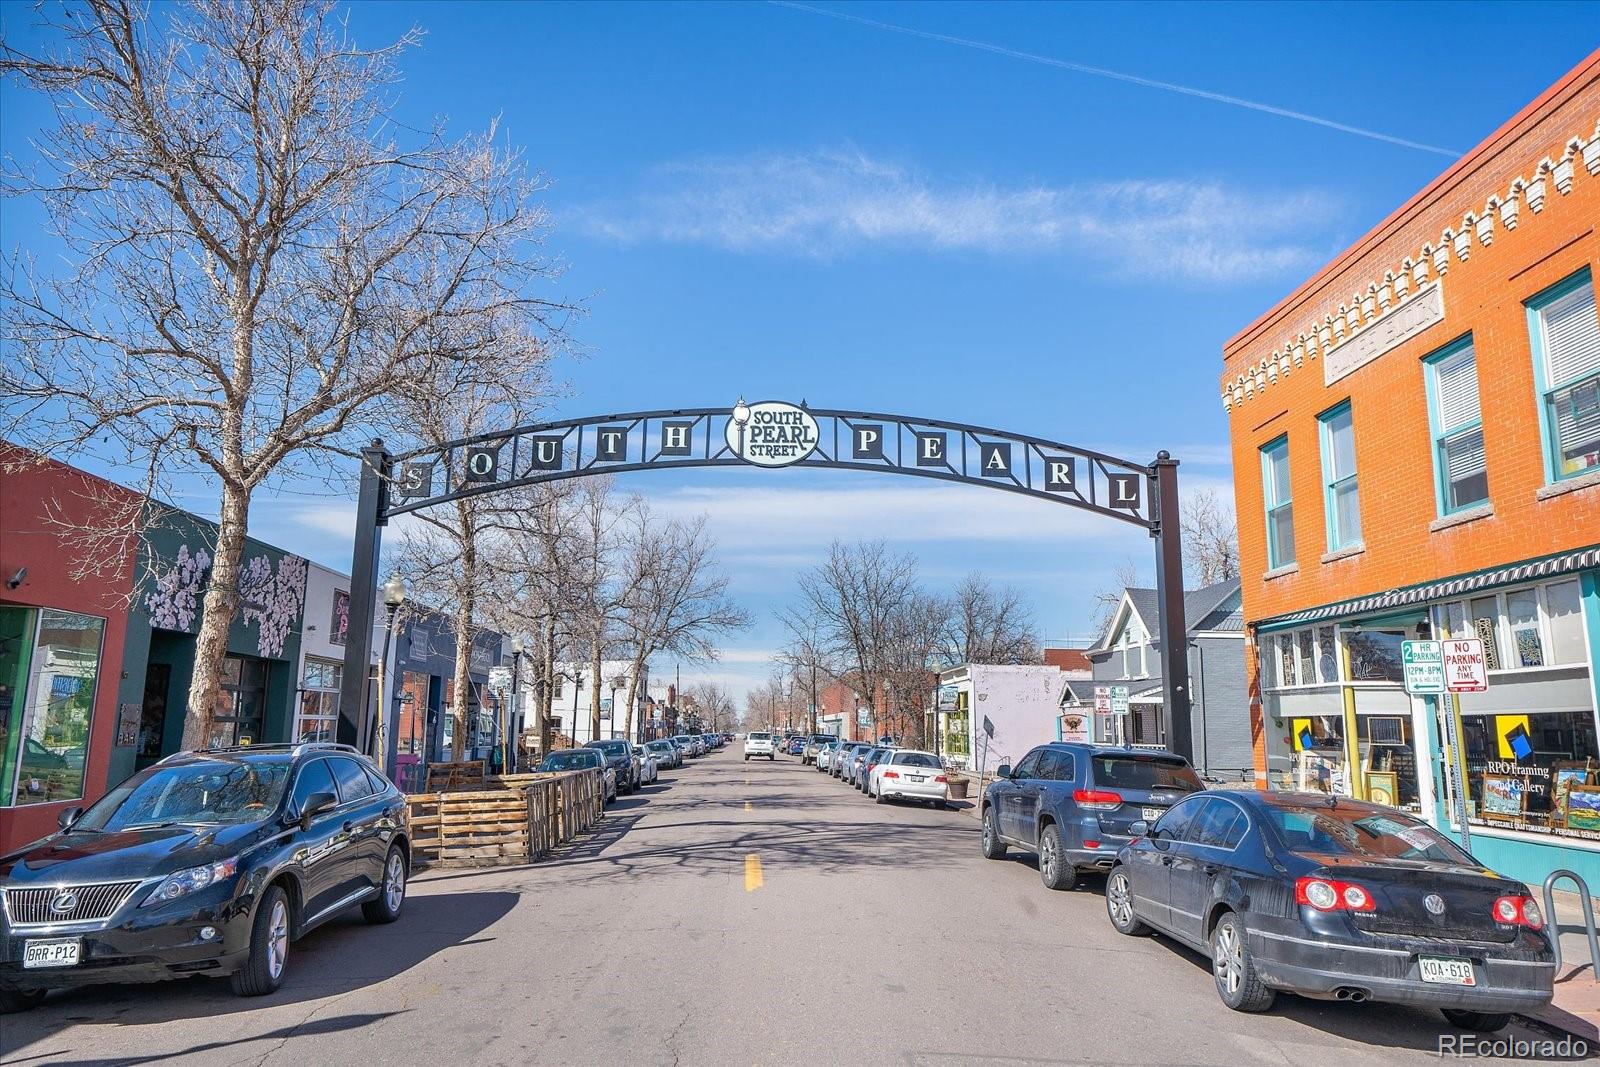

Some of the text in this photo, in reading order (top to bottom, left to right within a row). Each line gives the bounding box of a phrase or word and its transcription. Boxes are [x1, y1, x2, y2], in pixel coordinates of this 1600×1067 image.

[754, 411, 803, 425] SOUTH
[750, 425, 815, 450] PEARL
[750, 444, 798, 458] STREET
[406, 426, 688, 491] SOUTH
[858, 430, 1137, 501] PEARL
[1404, 645, 1412, 660] 2
[1420, 644, 1431, 652] HR
[1454, 642, 1470, 653] NO
[1413, 652, 1440, 661] PARKING
[1446, 653, 1482, 665] PARKING
[1457, 672, 1474, 680] TIME
[1488, 761, 1549, 779] RPO Framing
[1511, 779, 1545, 795] Gallery
[1148, 793, 1165, 801] Jeep
[1487, 819, 1514, 829] IMPECCABLE
[1555, 827, 1580, 838] PERSONAL
